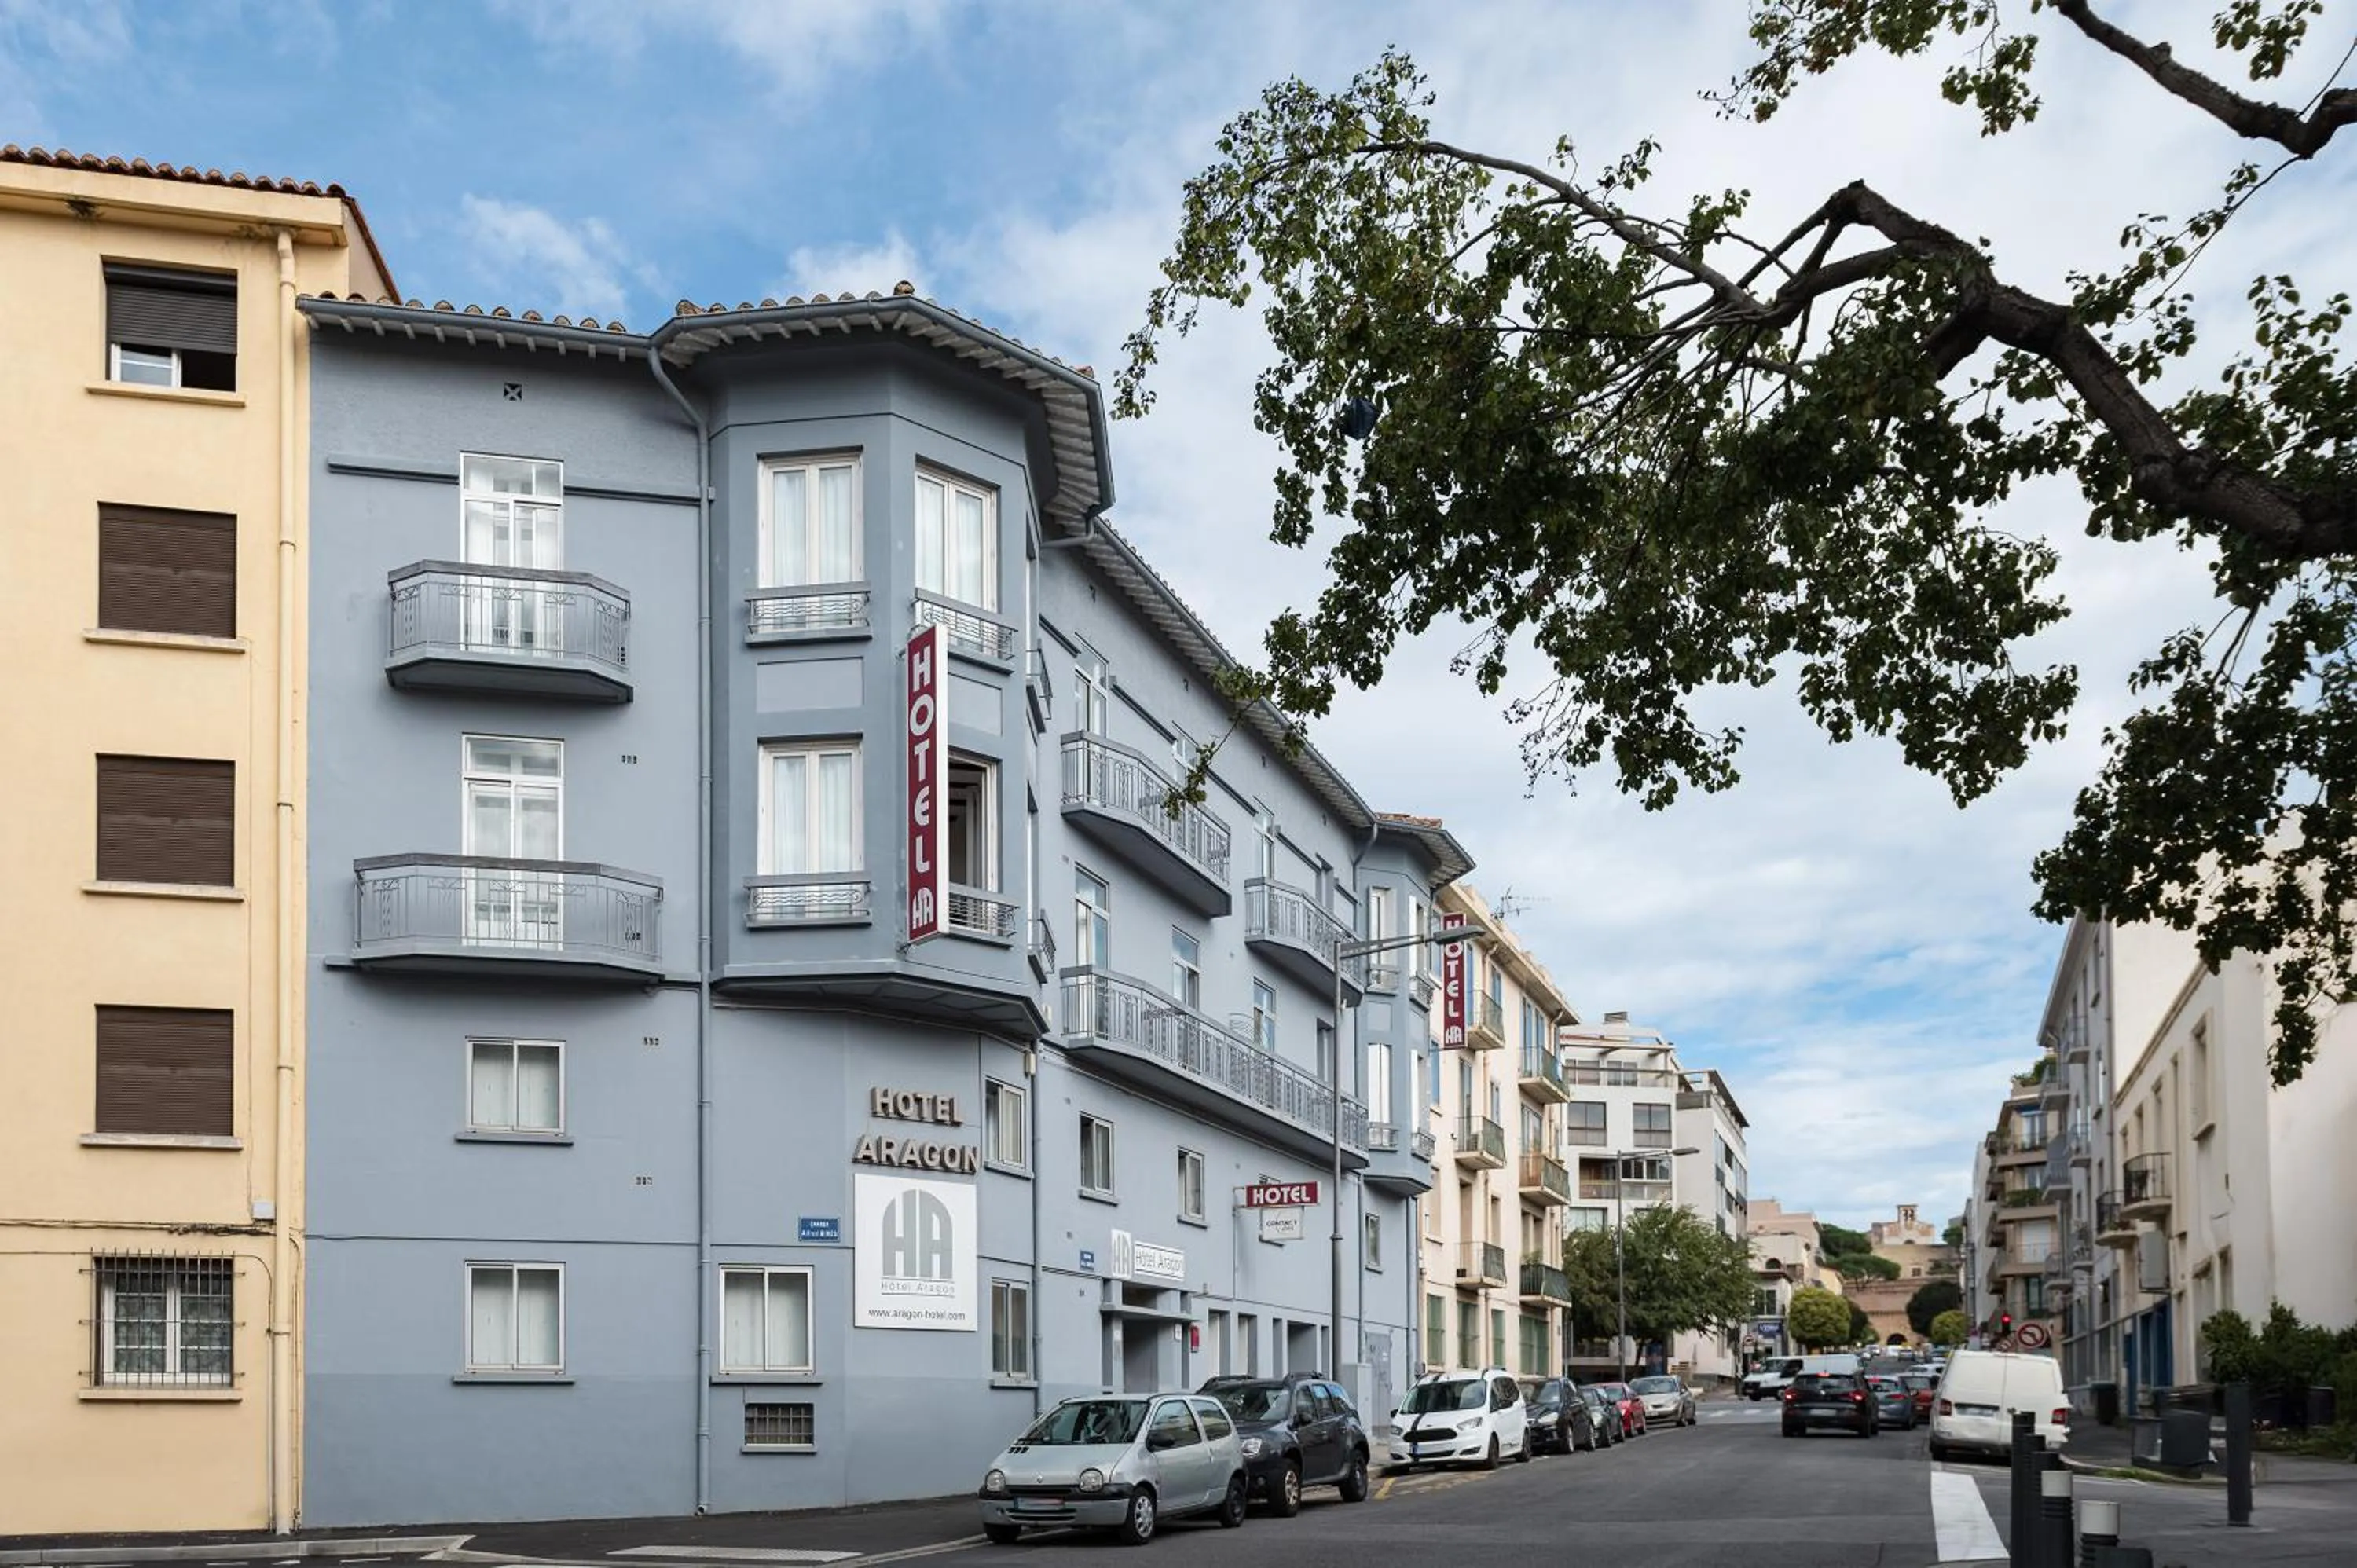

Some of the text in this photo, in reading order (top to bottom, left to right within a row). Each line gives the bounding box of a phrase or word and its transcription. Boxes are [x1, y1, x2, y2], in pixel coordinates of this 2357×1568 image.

[909, 644, 935, 874] HOTEL
[871, 1087, 962, 1125] HOTEL
[853, 1135, 981, 1174] ARAGON
[1253, 1185, 1311, 1204] HOTEL
[917, 1282, 955, 1295] Aragon
[868, 1307, 966, 1321] www.aragon-hotel.com
